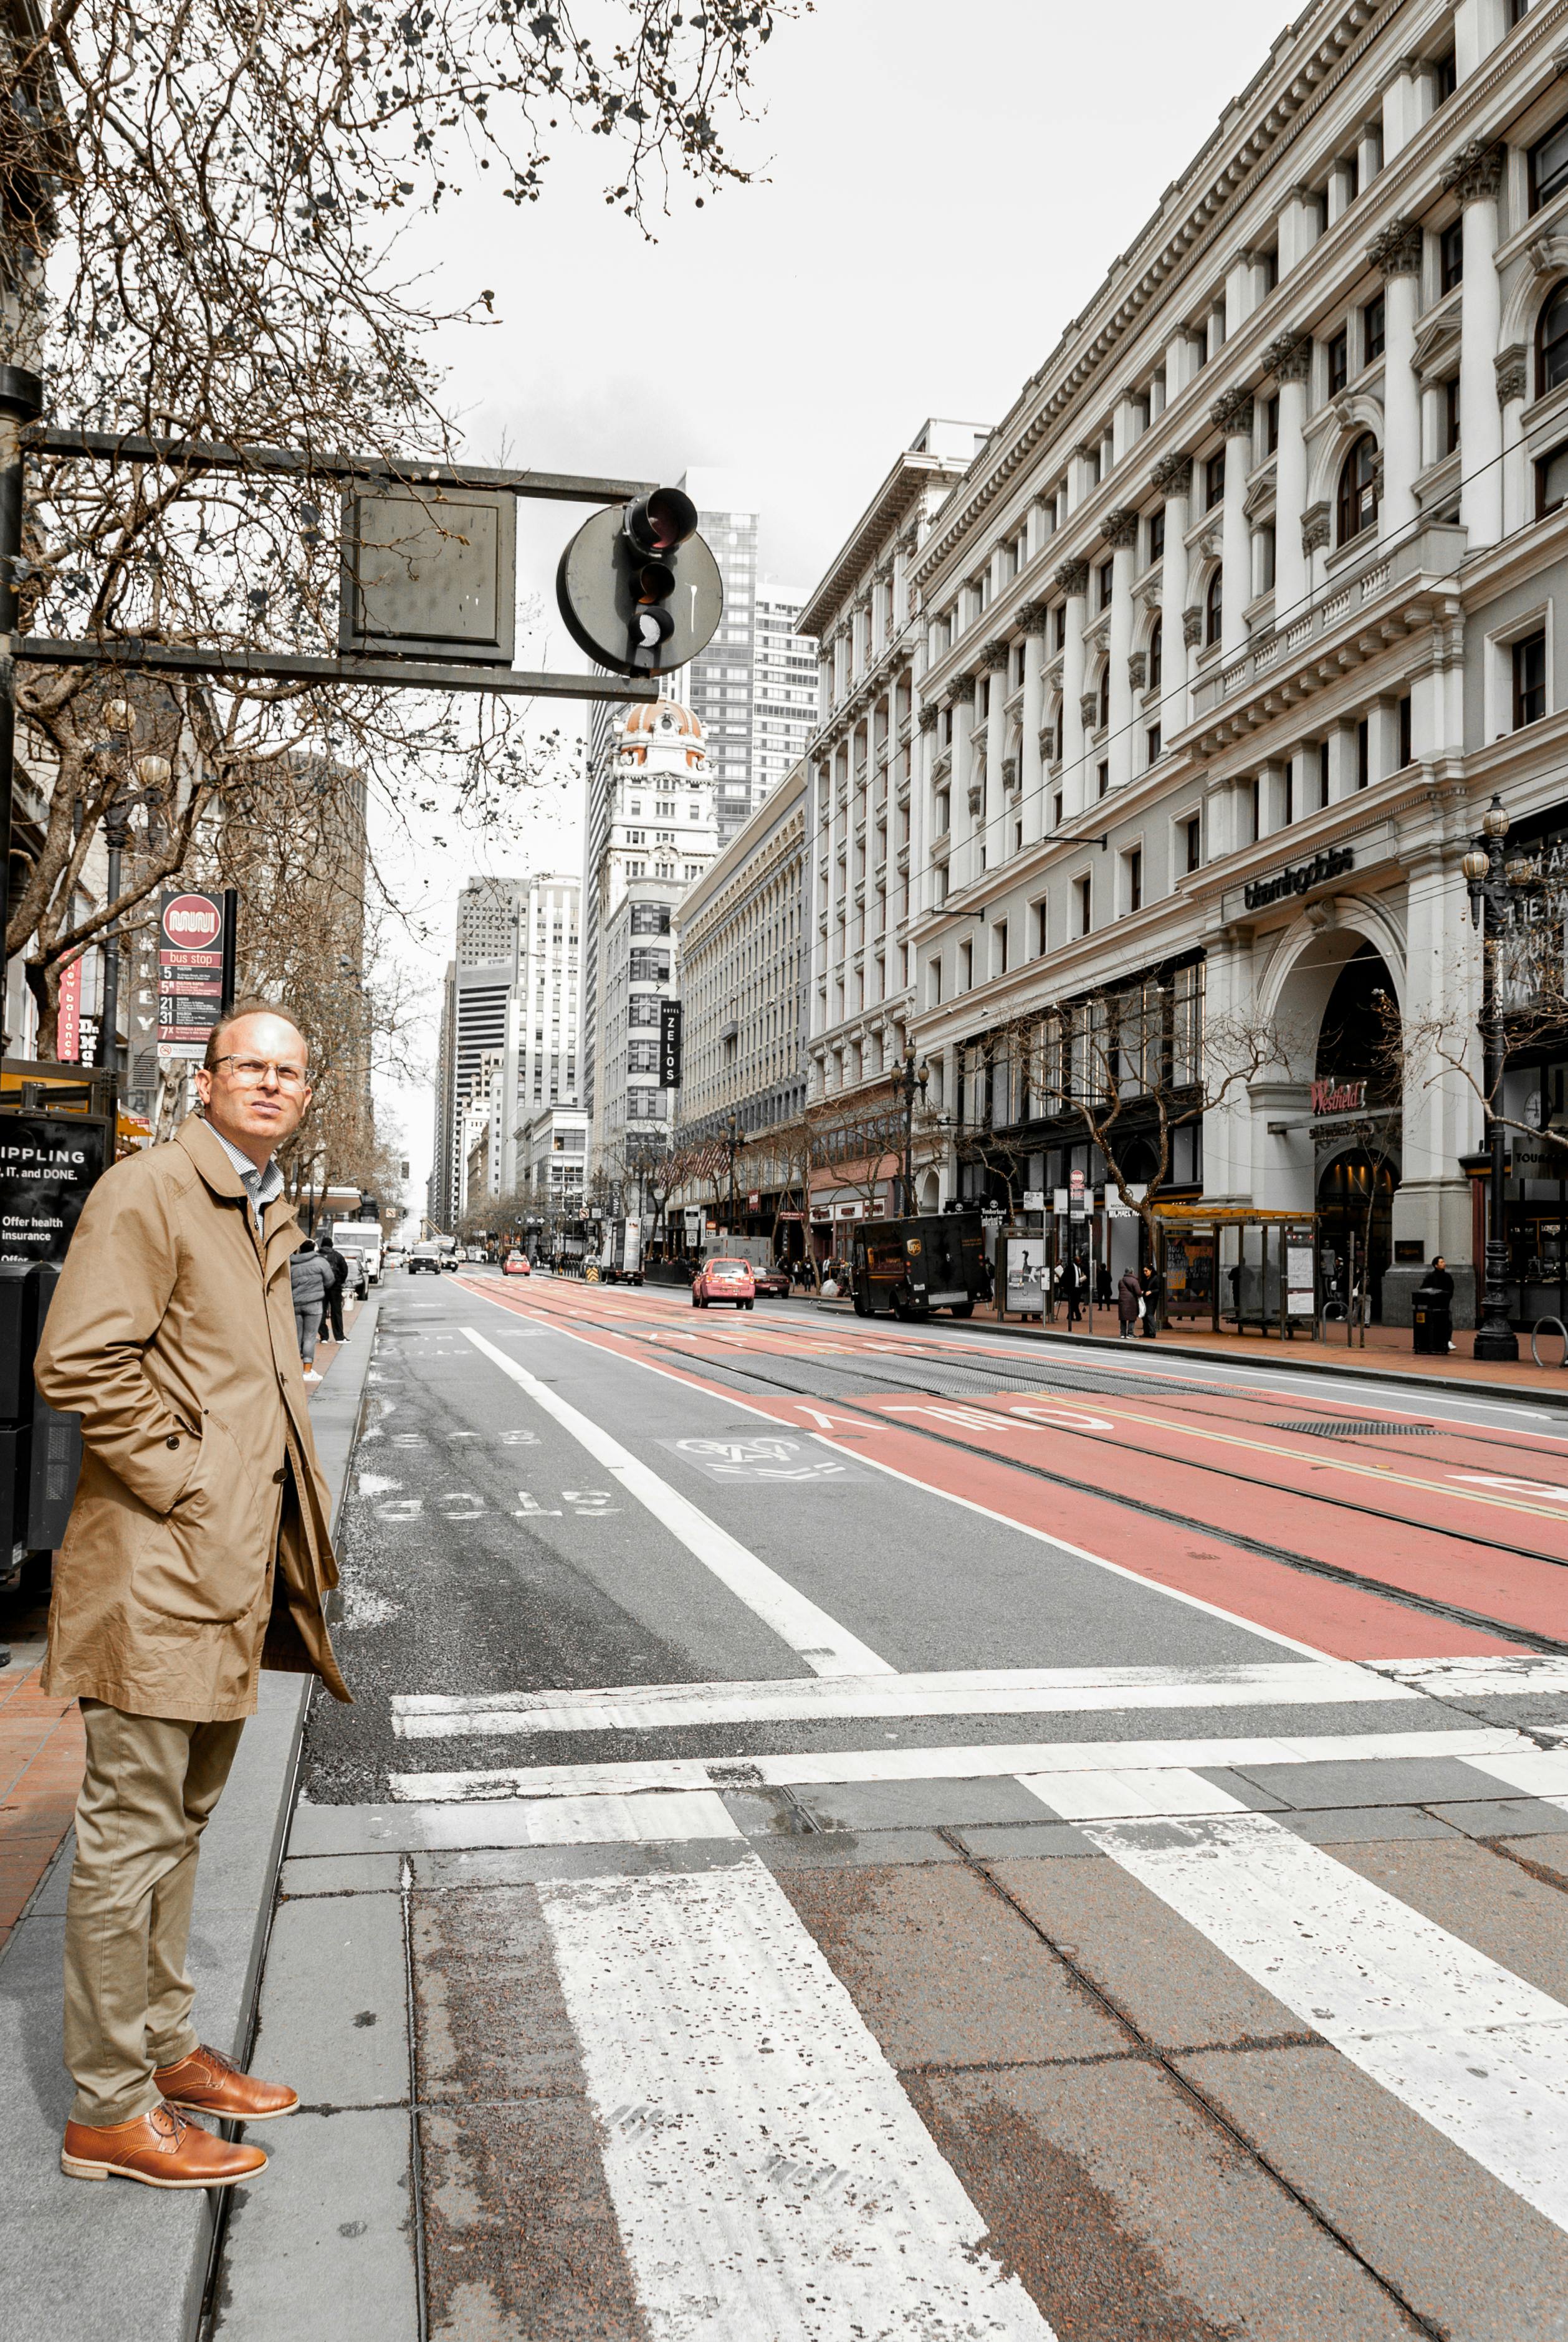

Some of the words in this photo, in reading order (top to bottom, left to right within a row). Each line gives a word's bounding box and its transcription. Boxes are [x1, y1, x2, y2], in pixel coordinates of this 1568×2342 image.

[170, 952, 188, 963] bus
[191, 954, 213, 967] stop
[164, 967, 172, 979] 5
[160, 997, 173, 1010] 21
[160, 1011, 173, 1025] 31
[64, 993, 74, 1057] balance
[666, 1017, 675, 1080] ZELOS
[1310, 1079, 1359, 1114] Westfield
[21, 1169, 41, 1178] and
[44, 1169, 77, 1180] DONE.
[2, 1216, 29, 1226] Offer
[32, 1217, 63, 1228] health
[2, 1230, 51, 1241] insurance
[909, 1244, 920, 1253] ups
[794, 1404, 1114, 1430] ONLY
